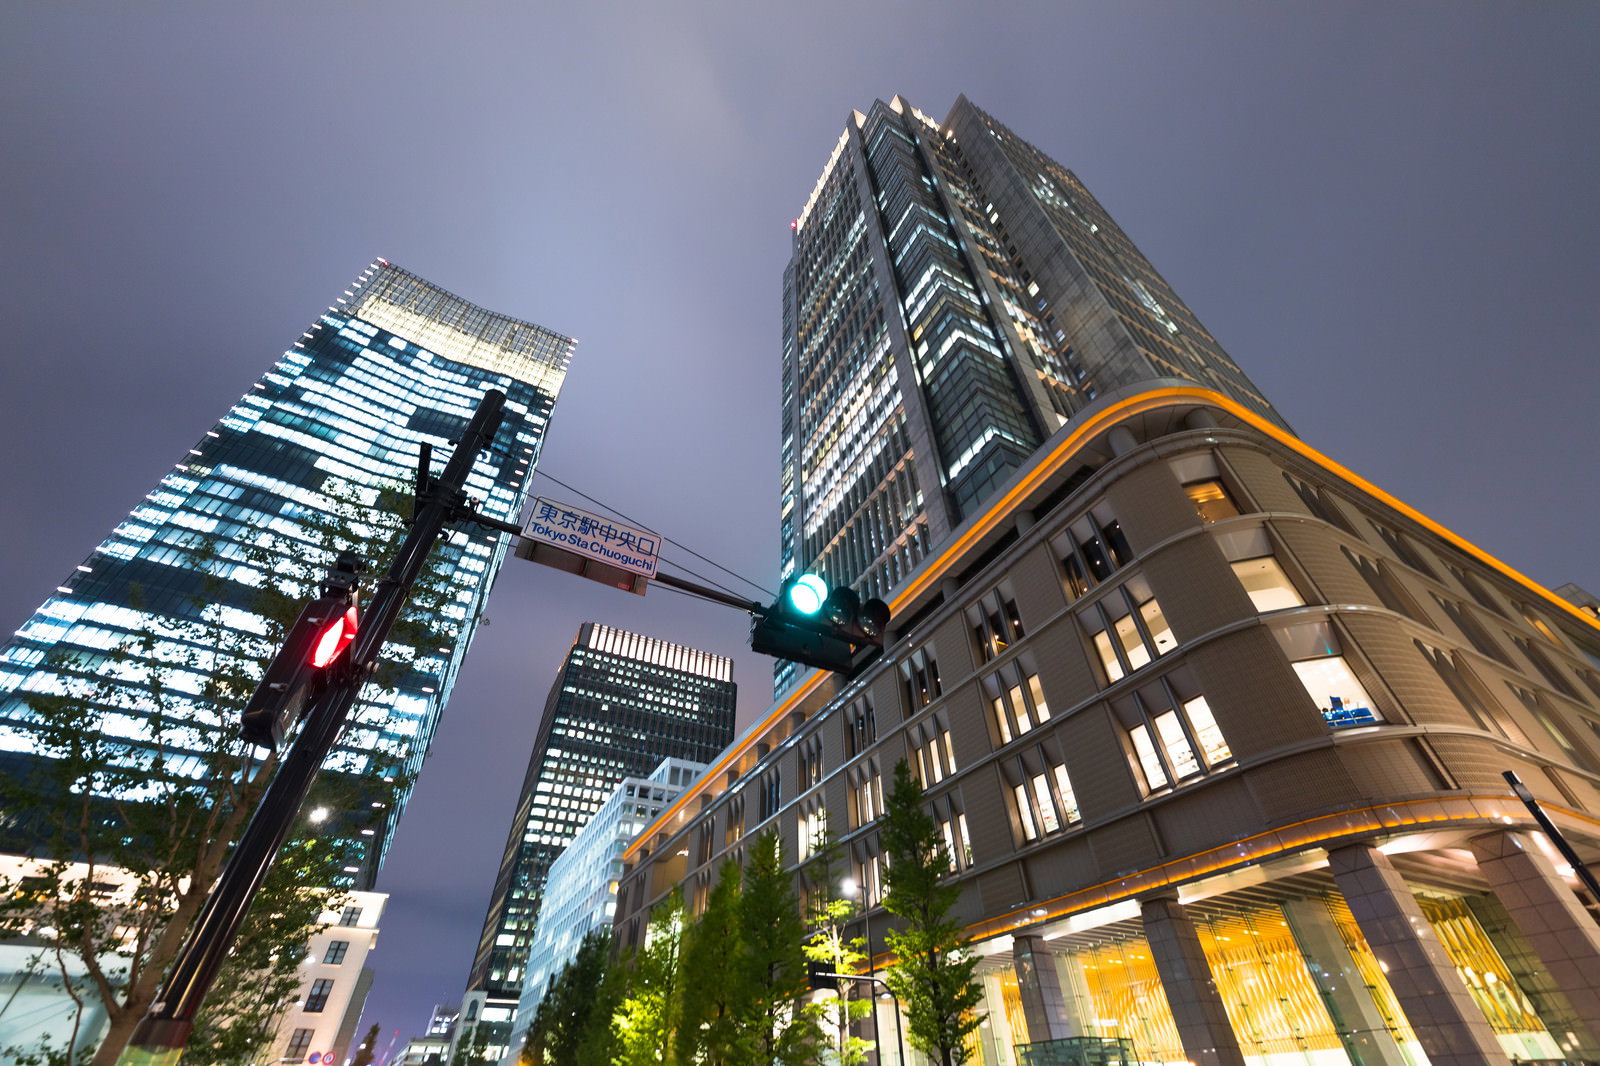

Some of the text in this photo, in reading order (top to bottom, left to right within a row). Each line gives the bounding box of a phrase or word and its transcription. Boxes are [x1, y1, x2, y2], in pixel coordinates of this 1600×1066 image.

[531, 522, 567, 542] Tokyo
[589, 542, 653, 571] Chuoguchi
[536, 503, 655, 556] 東京駅中央口
